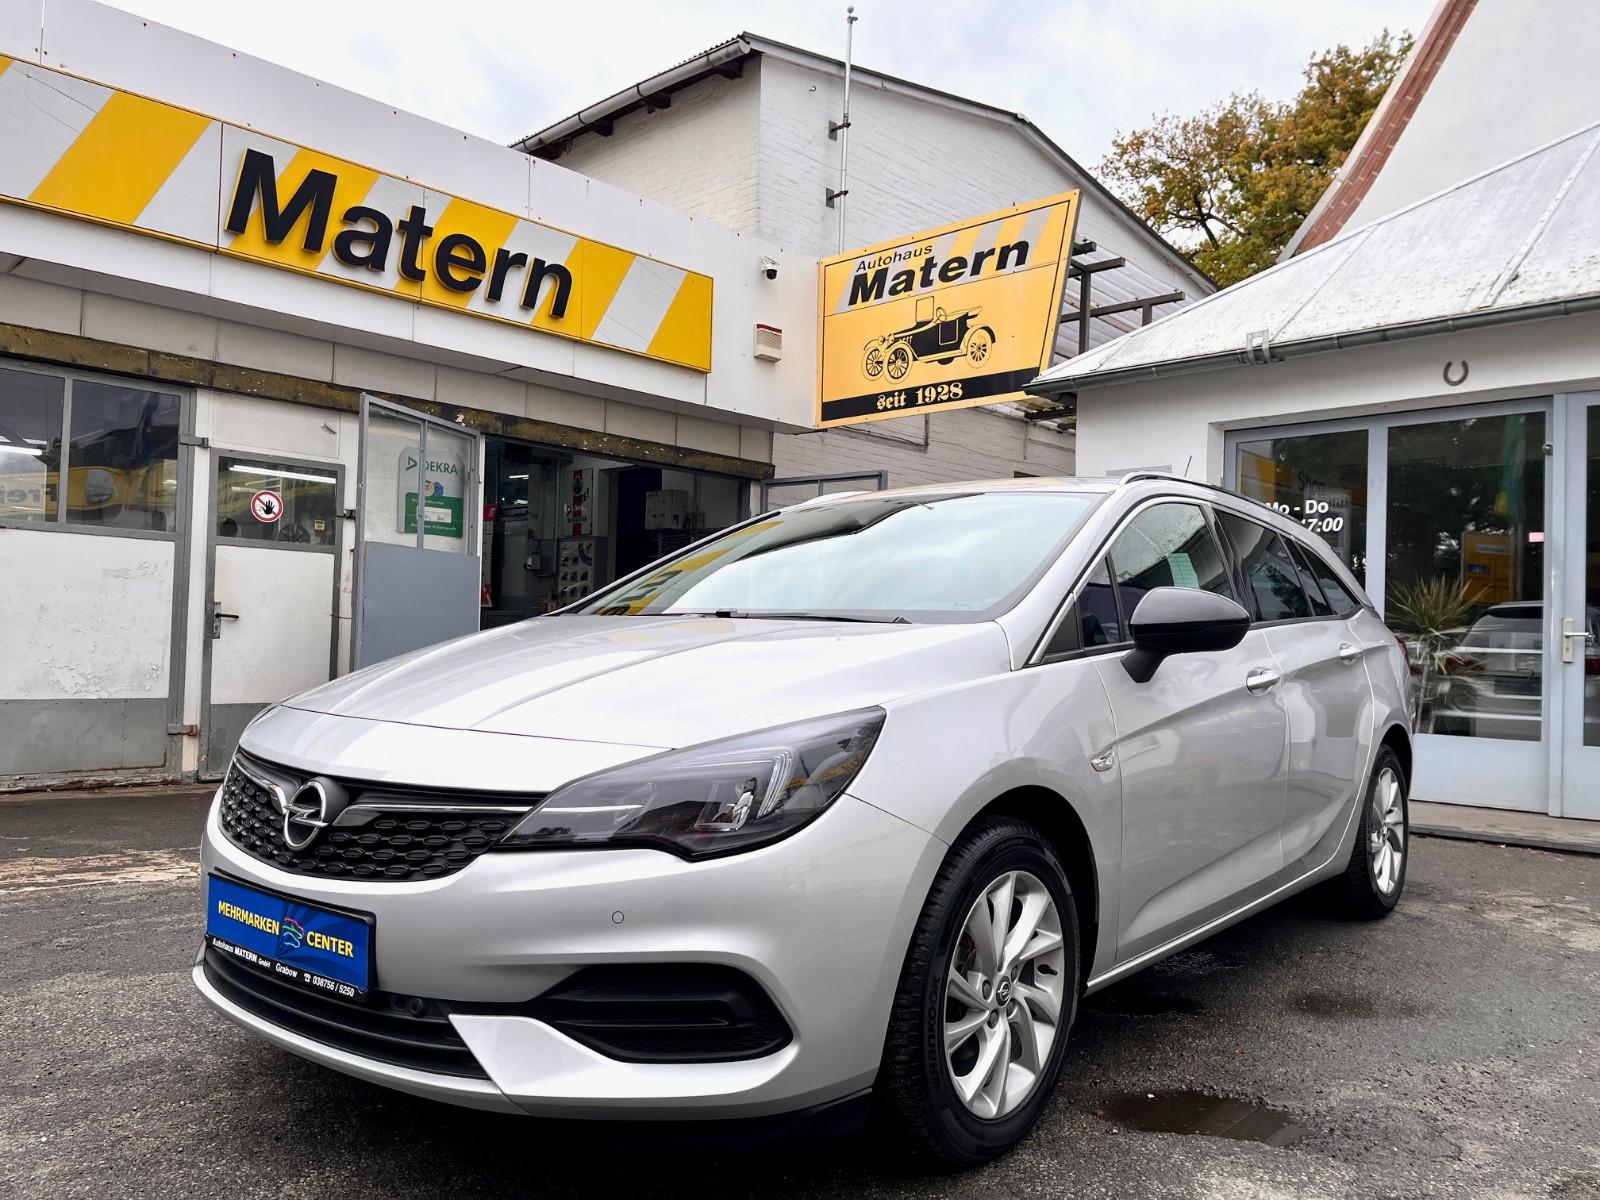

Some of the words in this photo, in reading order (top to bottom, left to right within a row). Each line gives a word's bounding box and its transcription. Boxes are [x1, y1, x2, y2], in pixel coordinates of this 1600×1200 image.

[224, 147, 573, 319] Matern
[855, 245, 933, 273] Autohaus
[848, 240, 1029, 306] Matern
[876, 391, 907, 411] seit
[914, 382, 963, 405] 1928
[1305, 499, 1329, 514] Do
[218, 900, 280, 936] MEHRMARKEN
[306, 931, 354, 958] CENTER
[212, 938, 234, 953] Autohaus
[234, 946, 257, 963] MATERN
[275, 963, 298, 978] Grabow
[312, 975, 335, 990] 038756
[339, 984, 355, 997] 5250
